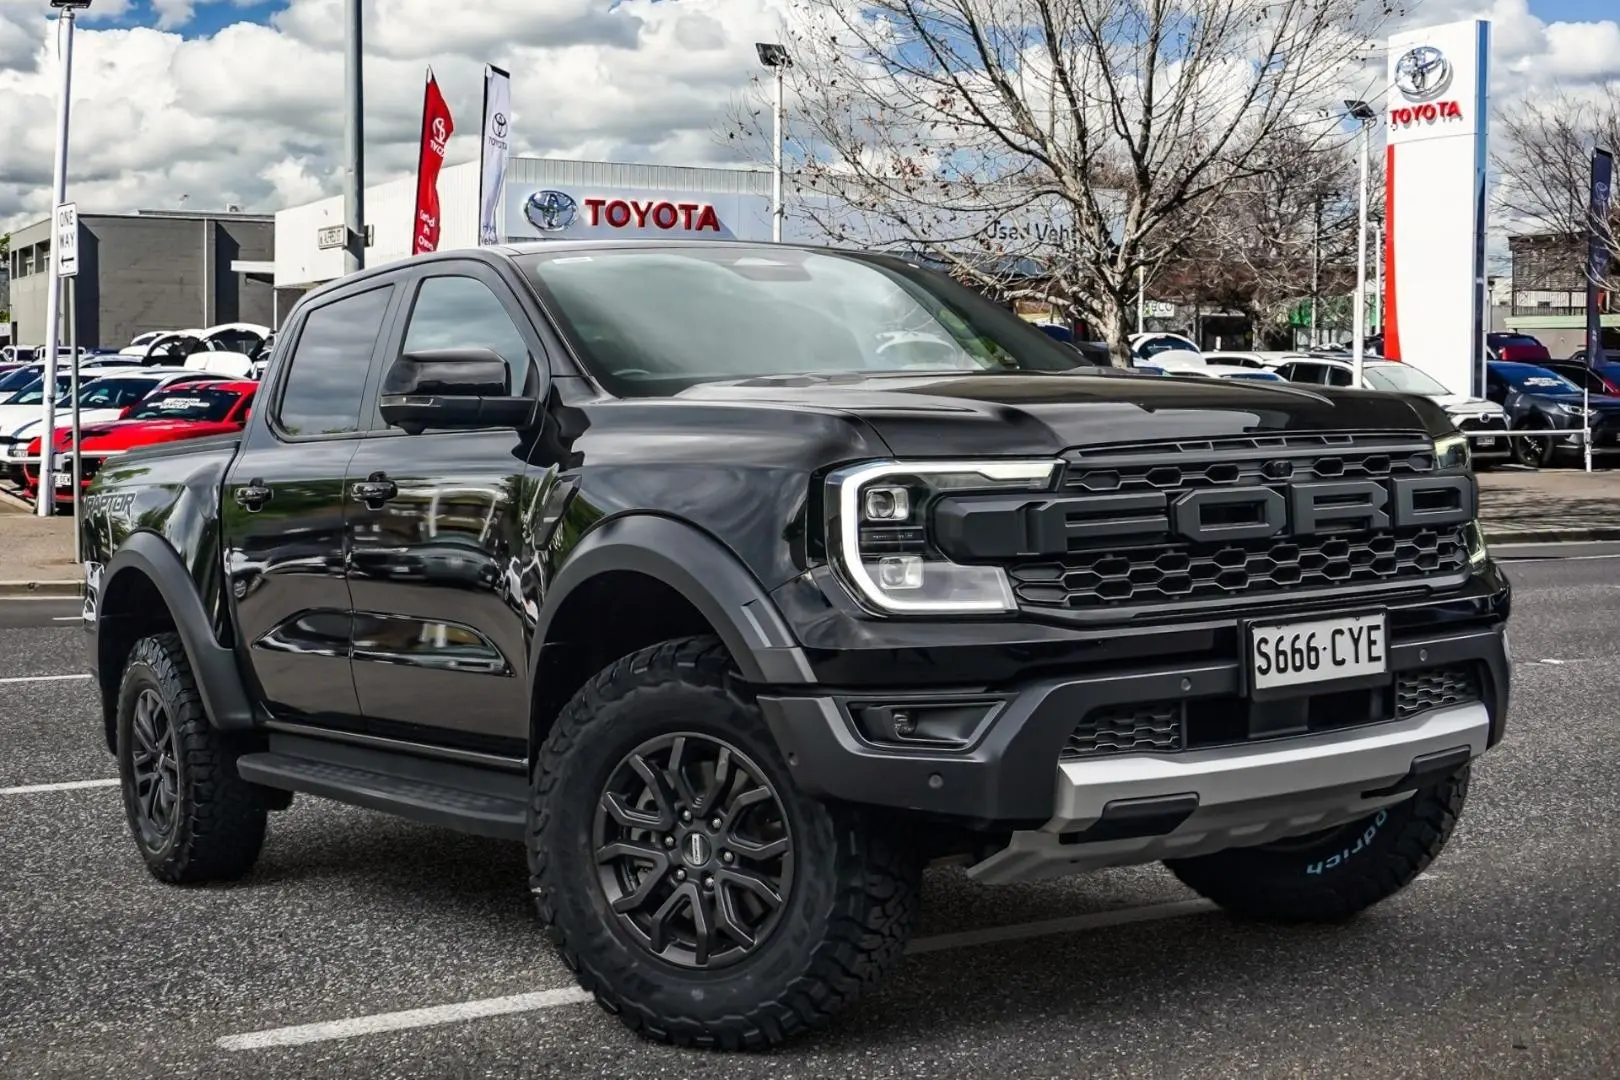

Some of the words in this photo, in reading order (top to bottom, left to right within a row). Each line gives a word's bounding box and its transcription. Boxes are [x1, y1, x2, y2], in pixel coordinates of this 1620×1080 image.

[1390, 101, 1461, 124] TOYOTA
[60, 210, 74, 227] ONE
[584, 199, 720, 232] TOYOTA
[59, 232, 75, 249] WAY
[84, 491, 137, 521] RAPTOR
[1024, 476, 1475, 554] FORD
